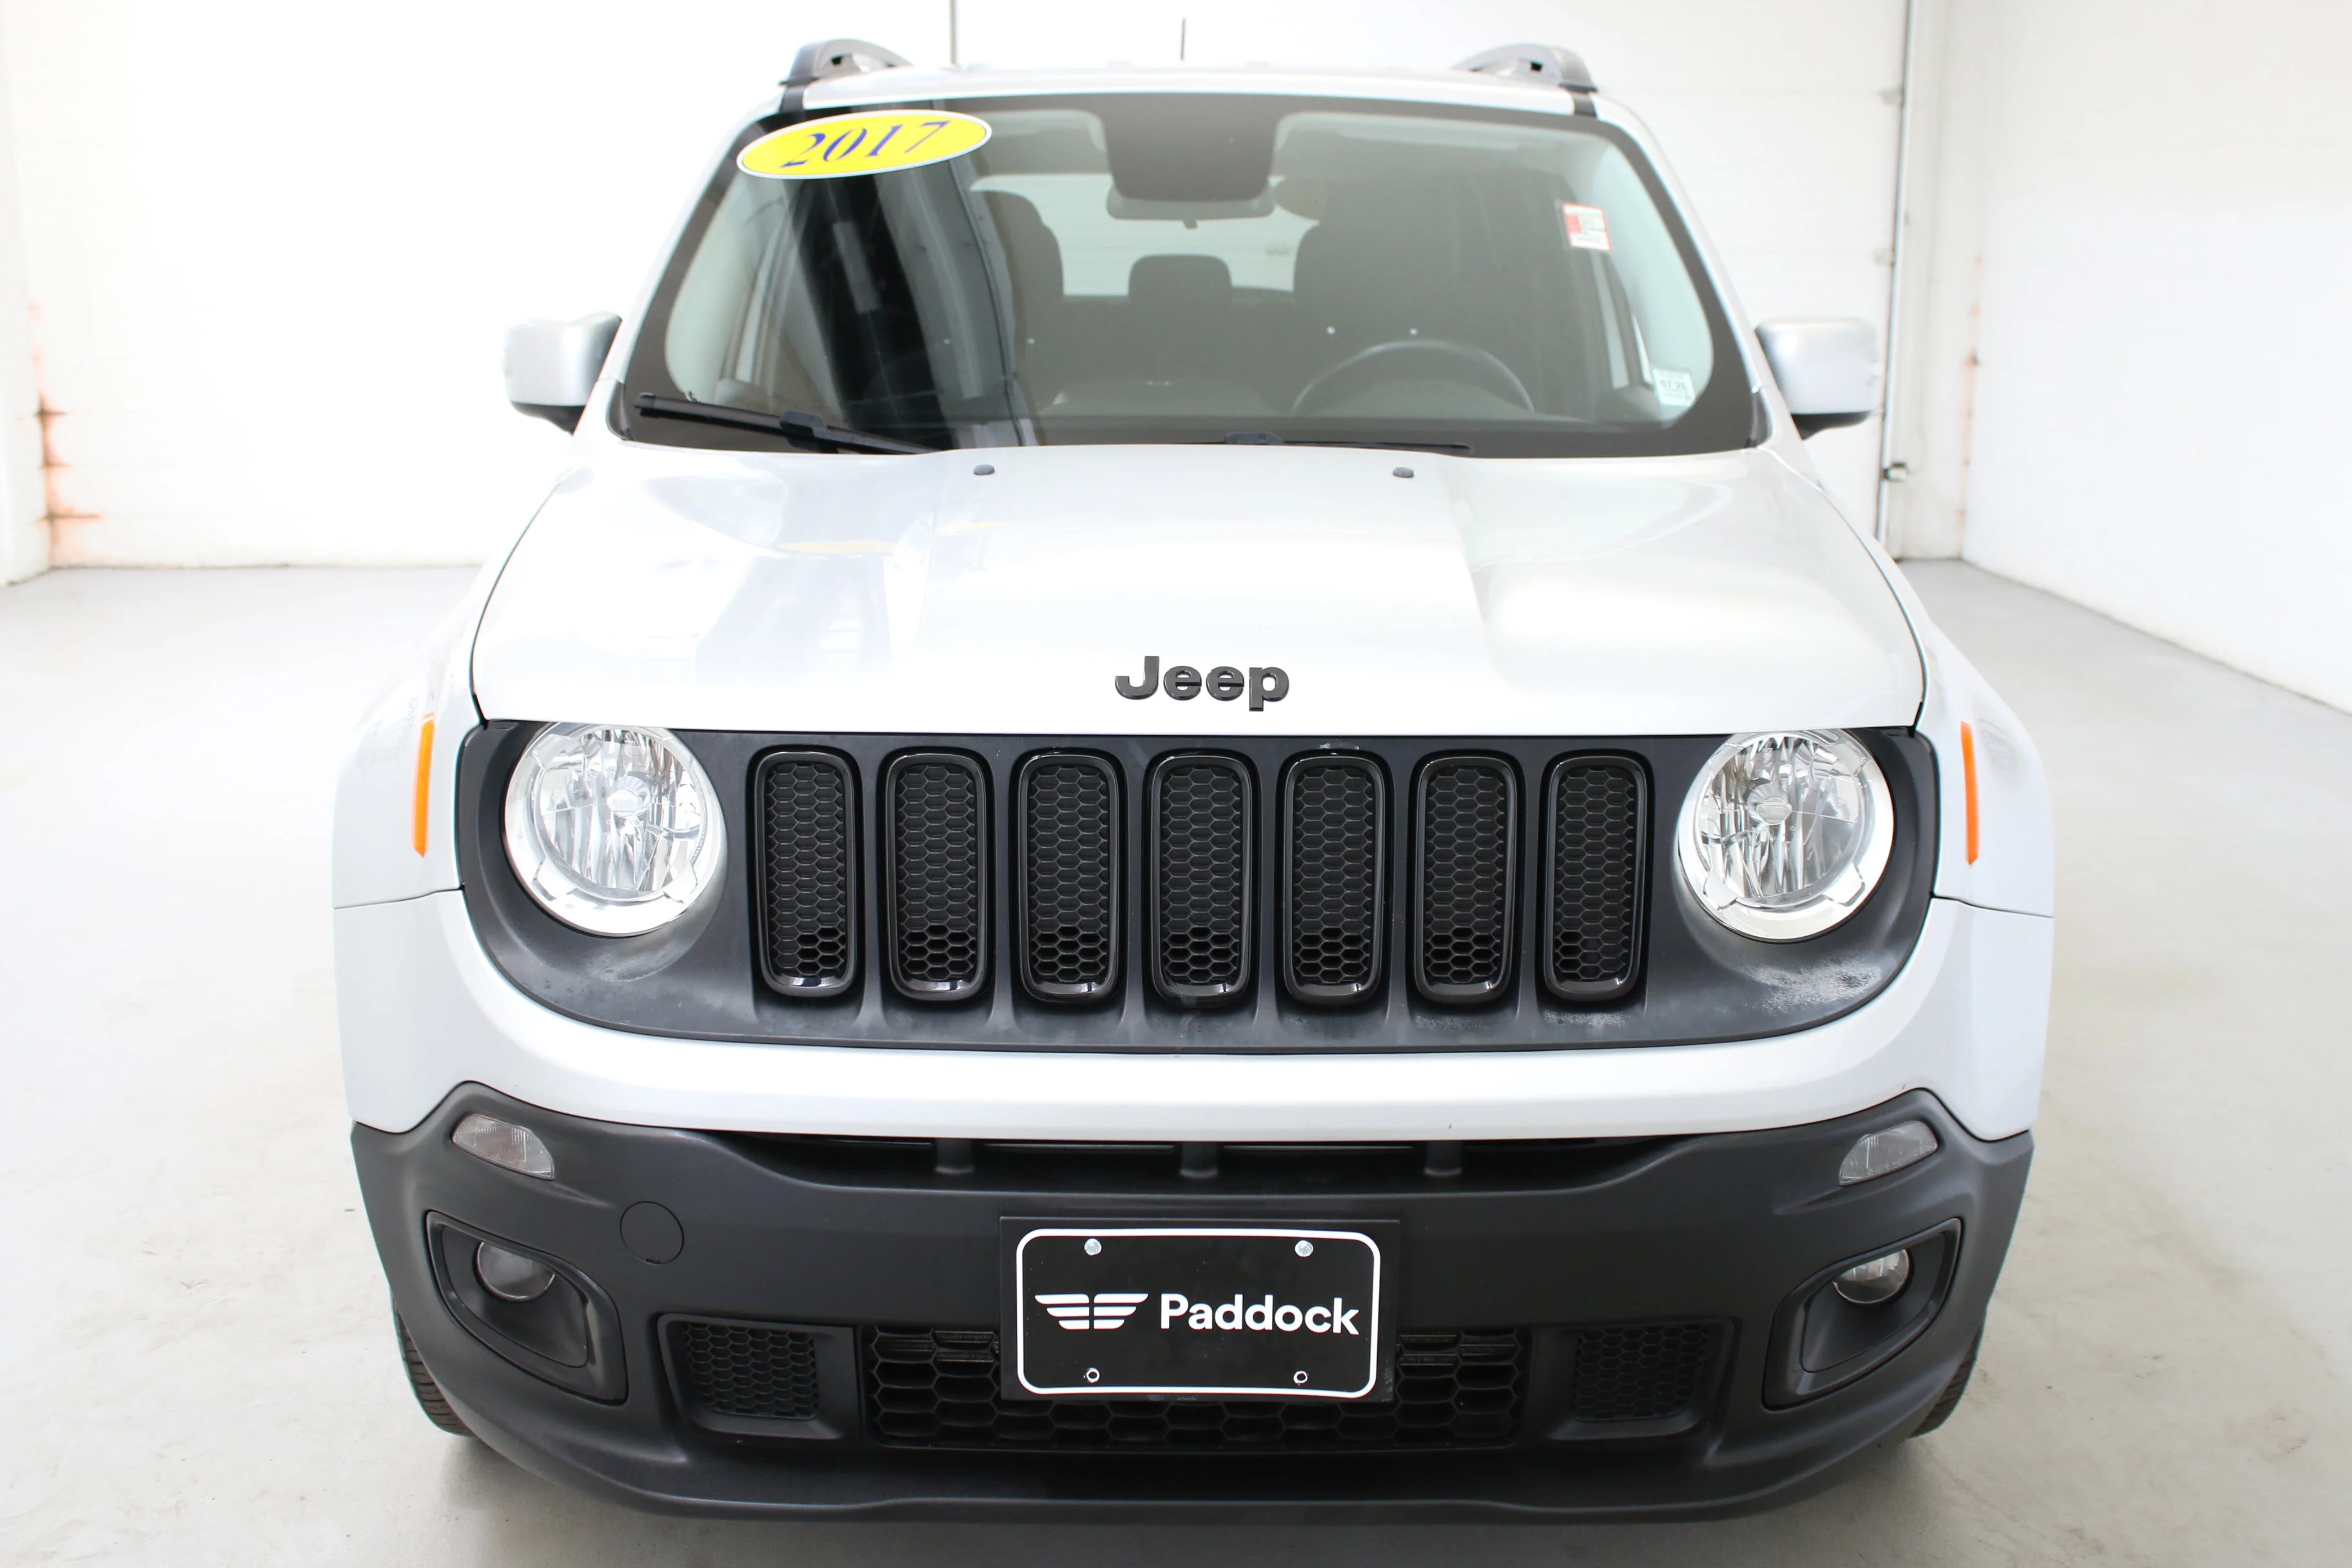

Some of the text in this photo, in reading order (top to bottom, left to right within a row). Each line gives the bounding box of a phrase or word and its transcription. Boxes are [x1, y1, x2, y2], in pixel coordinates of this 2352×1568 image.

[779, 120, 951, 169] 2017
[1115, 656, 1289, 711] Jeep
[1161, 1293, 1359, 1335] Paddock
